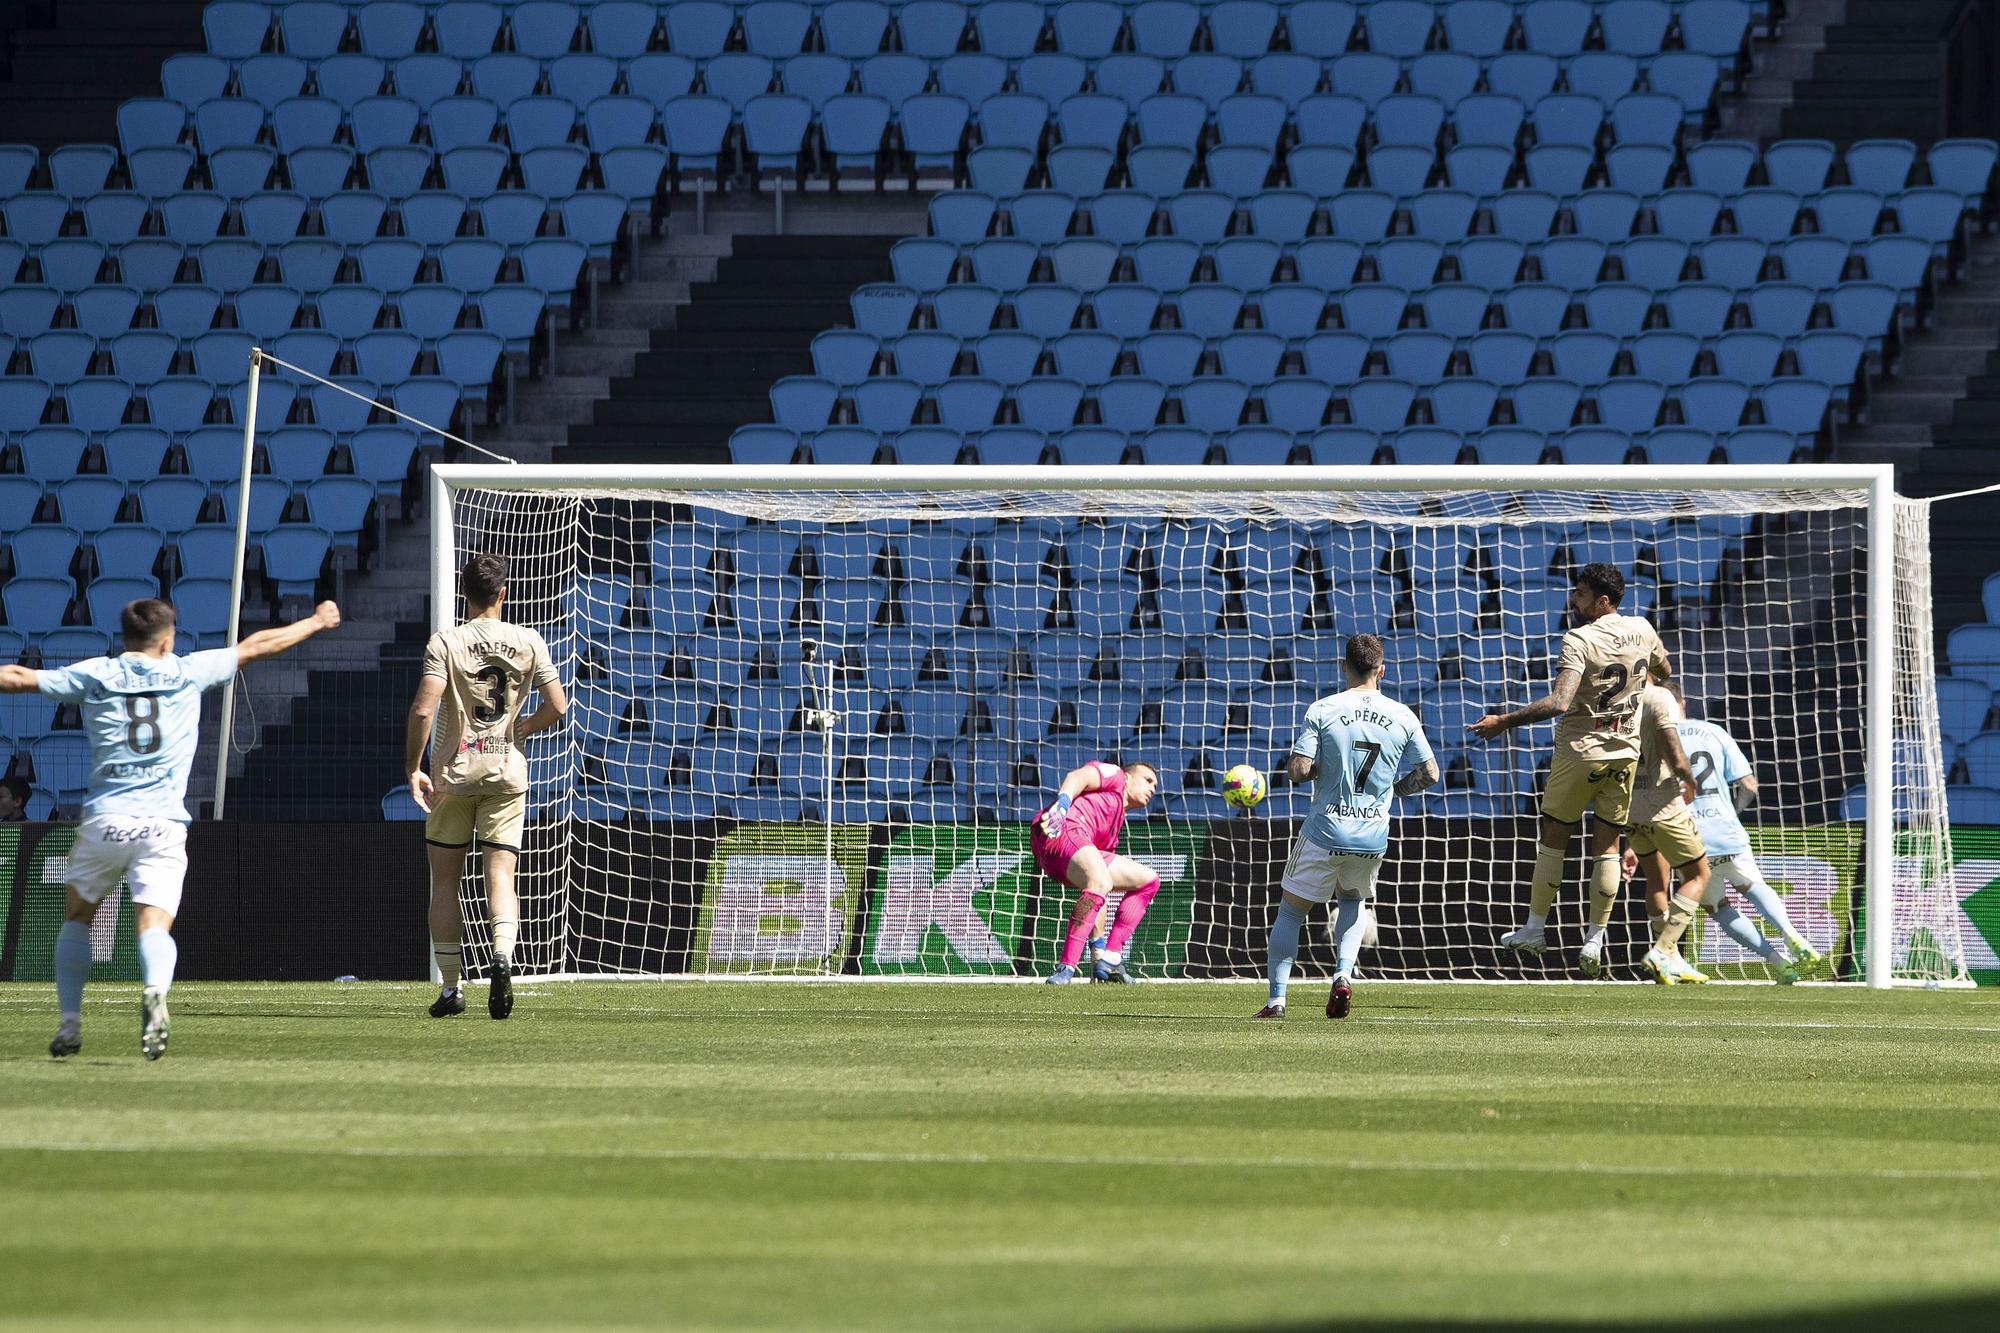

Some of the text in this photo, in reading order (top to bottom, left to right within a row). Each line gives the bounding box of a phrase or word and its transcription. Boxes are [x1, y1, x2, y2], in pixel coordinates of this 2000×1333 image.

[467, 641, 516, 659] MELERO
[472, 665, 507, 722] 3
[126, 693, 162, 755] 8
[483, 745, 510, 754] HORSE
[1352, 740, 1381, 796] 7
[1331, 804, 1383, 819] ABANCA
